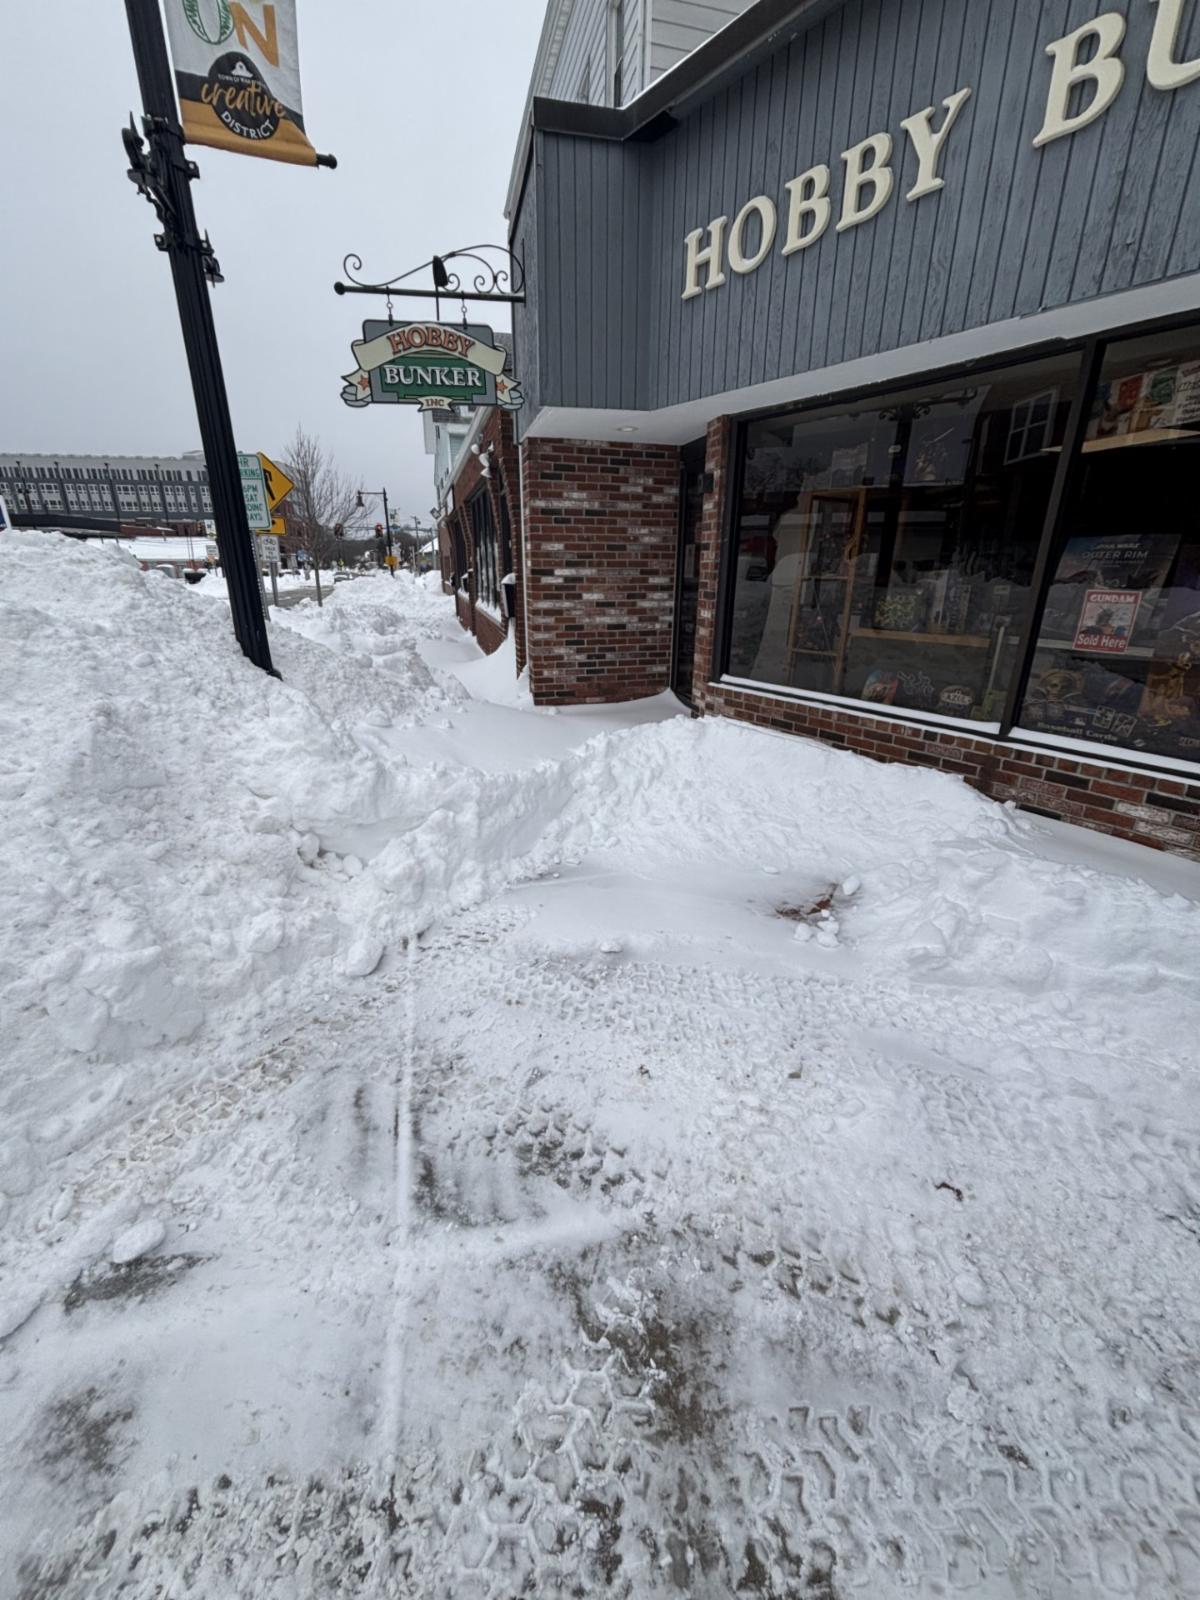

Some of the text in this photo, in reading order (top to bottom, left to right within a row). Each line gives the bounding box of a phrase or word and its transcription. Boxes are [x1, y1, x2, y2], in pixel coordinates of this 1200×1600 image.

[201, 80, 286, 117] creative
[221, 110, 274, 139] DISTRICT
[681, 87, 972, 300] HOBBY
[387, 326, 475, 357] HOBBY
[383, 364, 483, 387] BUNKER
[424, 398, 445, 408] INC
[1082, 550, 1149, 560] OUTER RIM
[1089, 594, 1137, 603] GUNDAM
[1077, 634, 1126, 649] Sold Here
